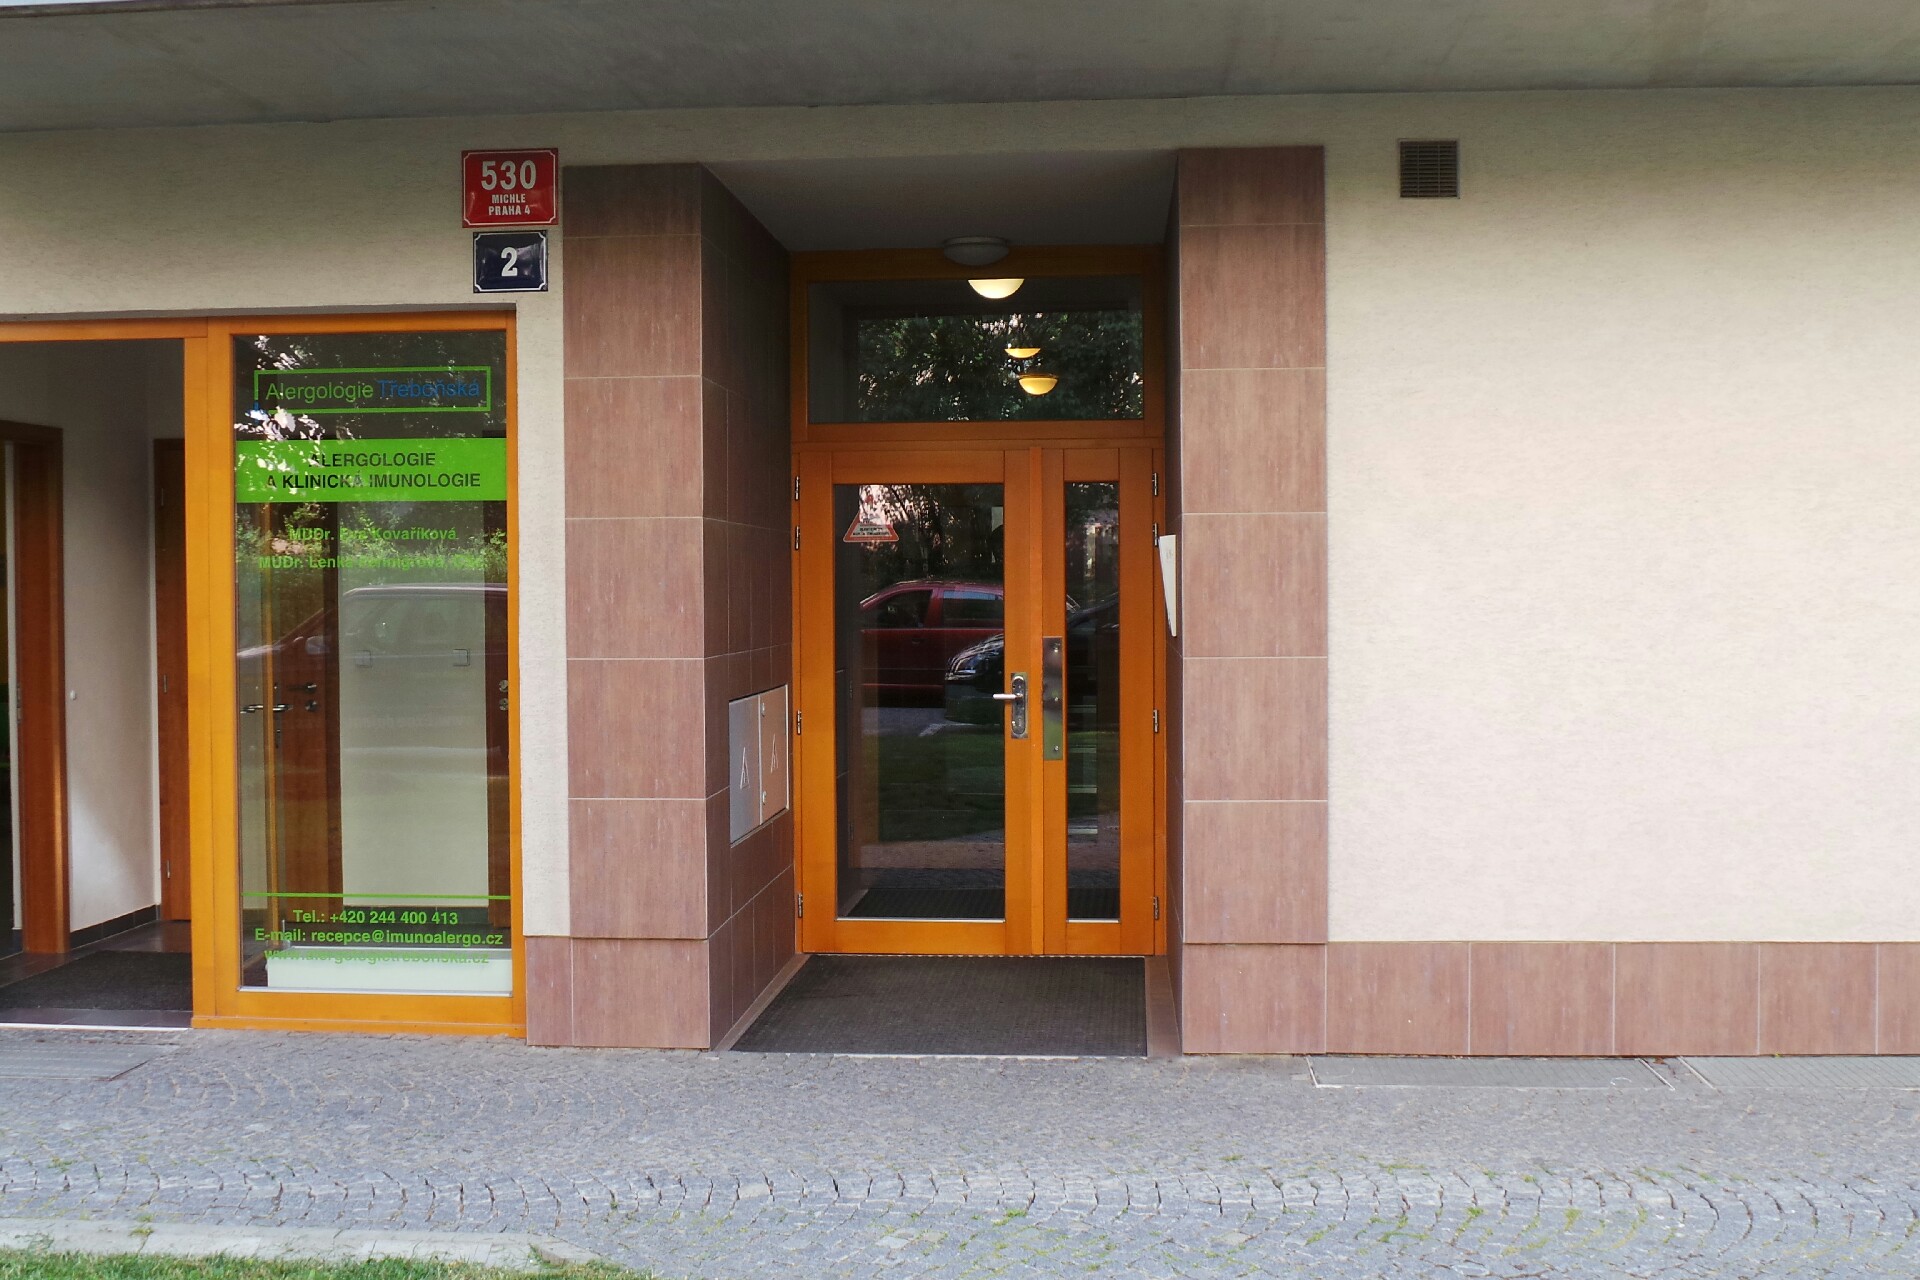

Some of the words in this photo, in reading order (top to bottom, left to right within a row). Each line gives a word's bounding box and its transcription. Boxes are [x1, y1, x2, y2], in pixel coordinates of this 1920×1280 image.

[481, 160, 537, 191] 530
[491, 193, 526, 204] MICHLE
[488, 206, 522, 216] PRAHA
[524, 205, 531, 215] 4
[500, 246, 518, 277] 2
[265, 382, 374, 403] Alergologie
[377, 378, 480, 398] Třeboňská
[308, 452, 436, 468] ALERGOLOGIE
[267, 475, 277, 488] A
[282, 470, 363, 489] KLINICKÁ
[369, 473, 481, 488] IMUNOLOGIE
[372, 526, 457, 541] Kovaříková
[259, 556, 303, 569] MUDr.
[293, 909, 325, 923] Tel.:
[330, 910, 366, 924] +420
[369, 911, 396, 924] 244
[400, 911, 428, 925] 400
[431, 912, 458, 925] 413
[254, 928, 306, 942] E-mail:
[311, 931, 503, 947] recepce@imunoalergo.cz
